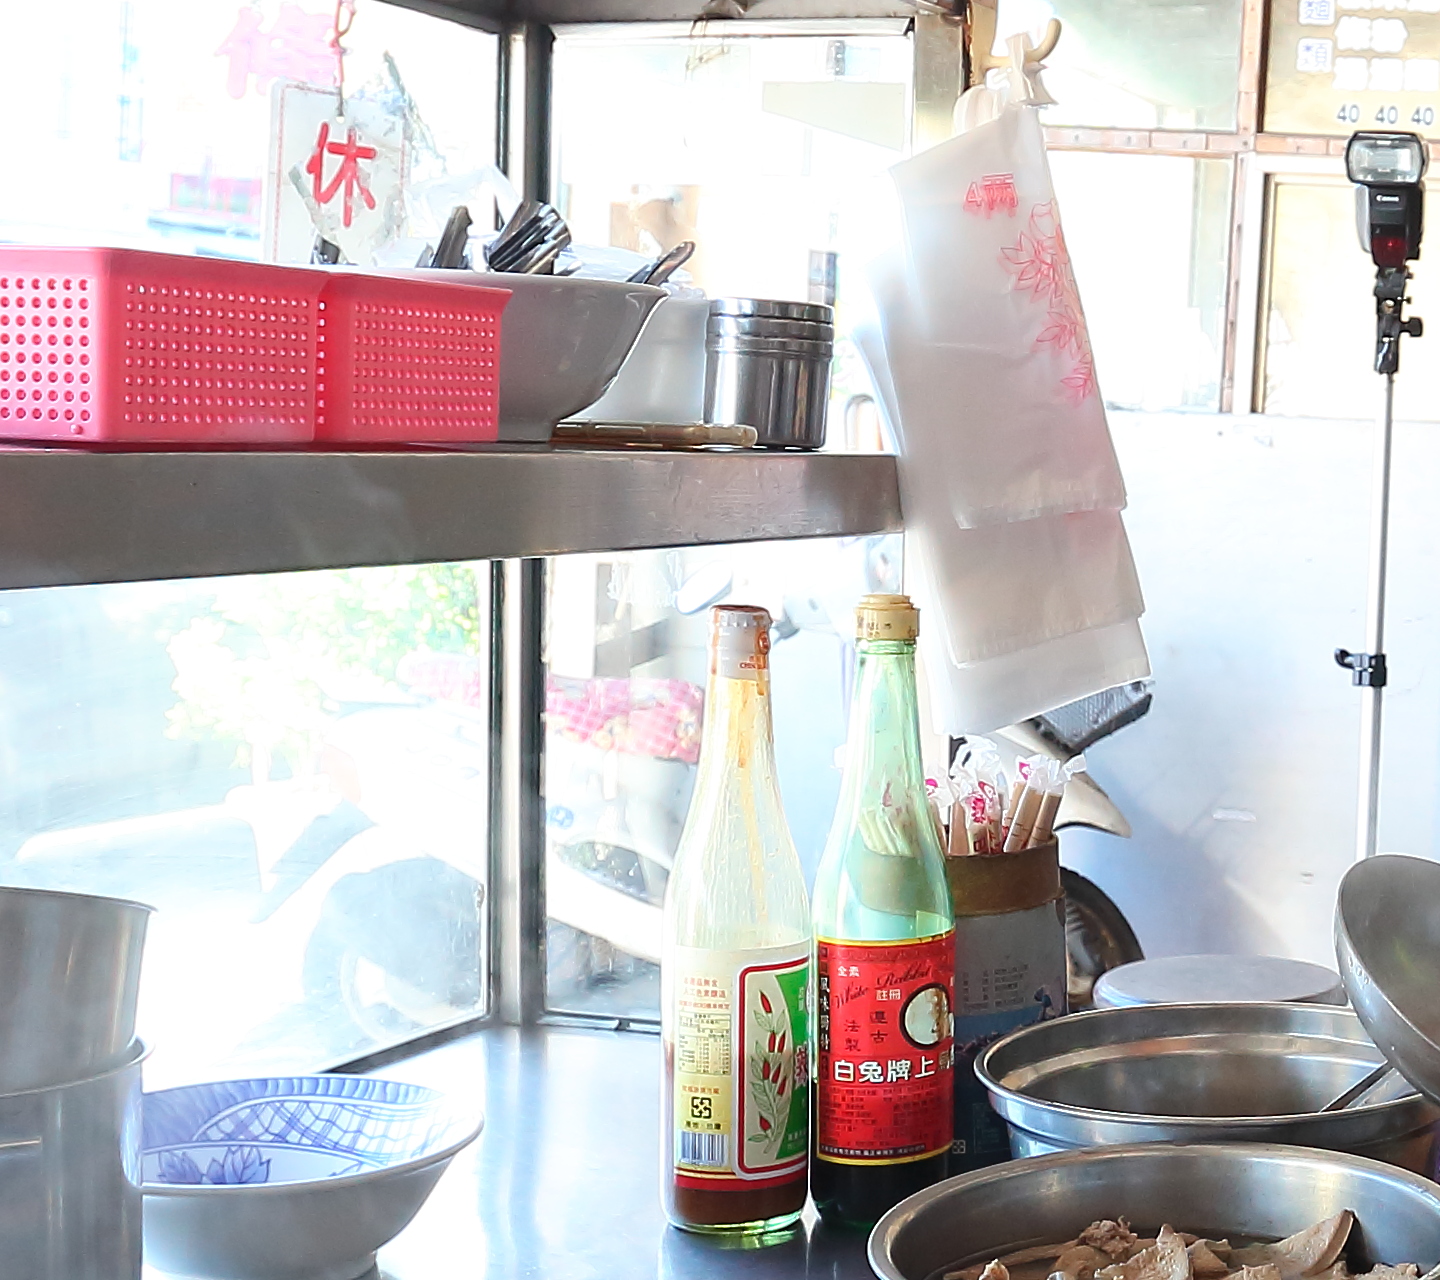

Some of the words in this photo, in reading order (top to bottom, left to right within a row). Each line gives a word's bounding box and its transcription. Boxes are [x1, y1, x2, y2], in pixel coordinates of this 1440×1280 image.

[1337, 104, 1360, 123] 40
[1375, 105, 1398, 124] 40
[1411, 106, 1434, 126] 40
[305, 121, 379, 229] 休
